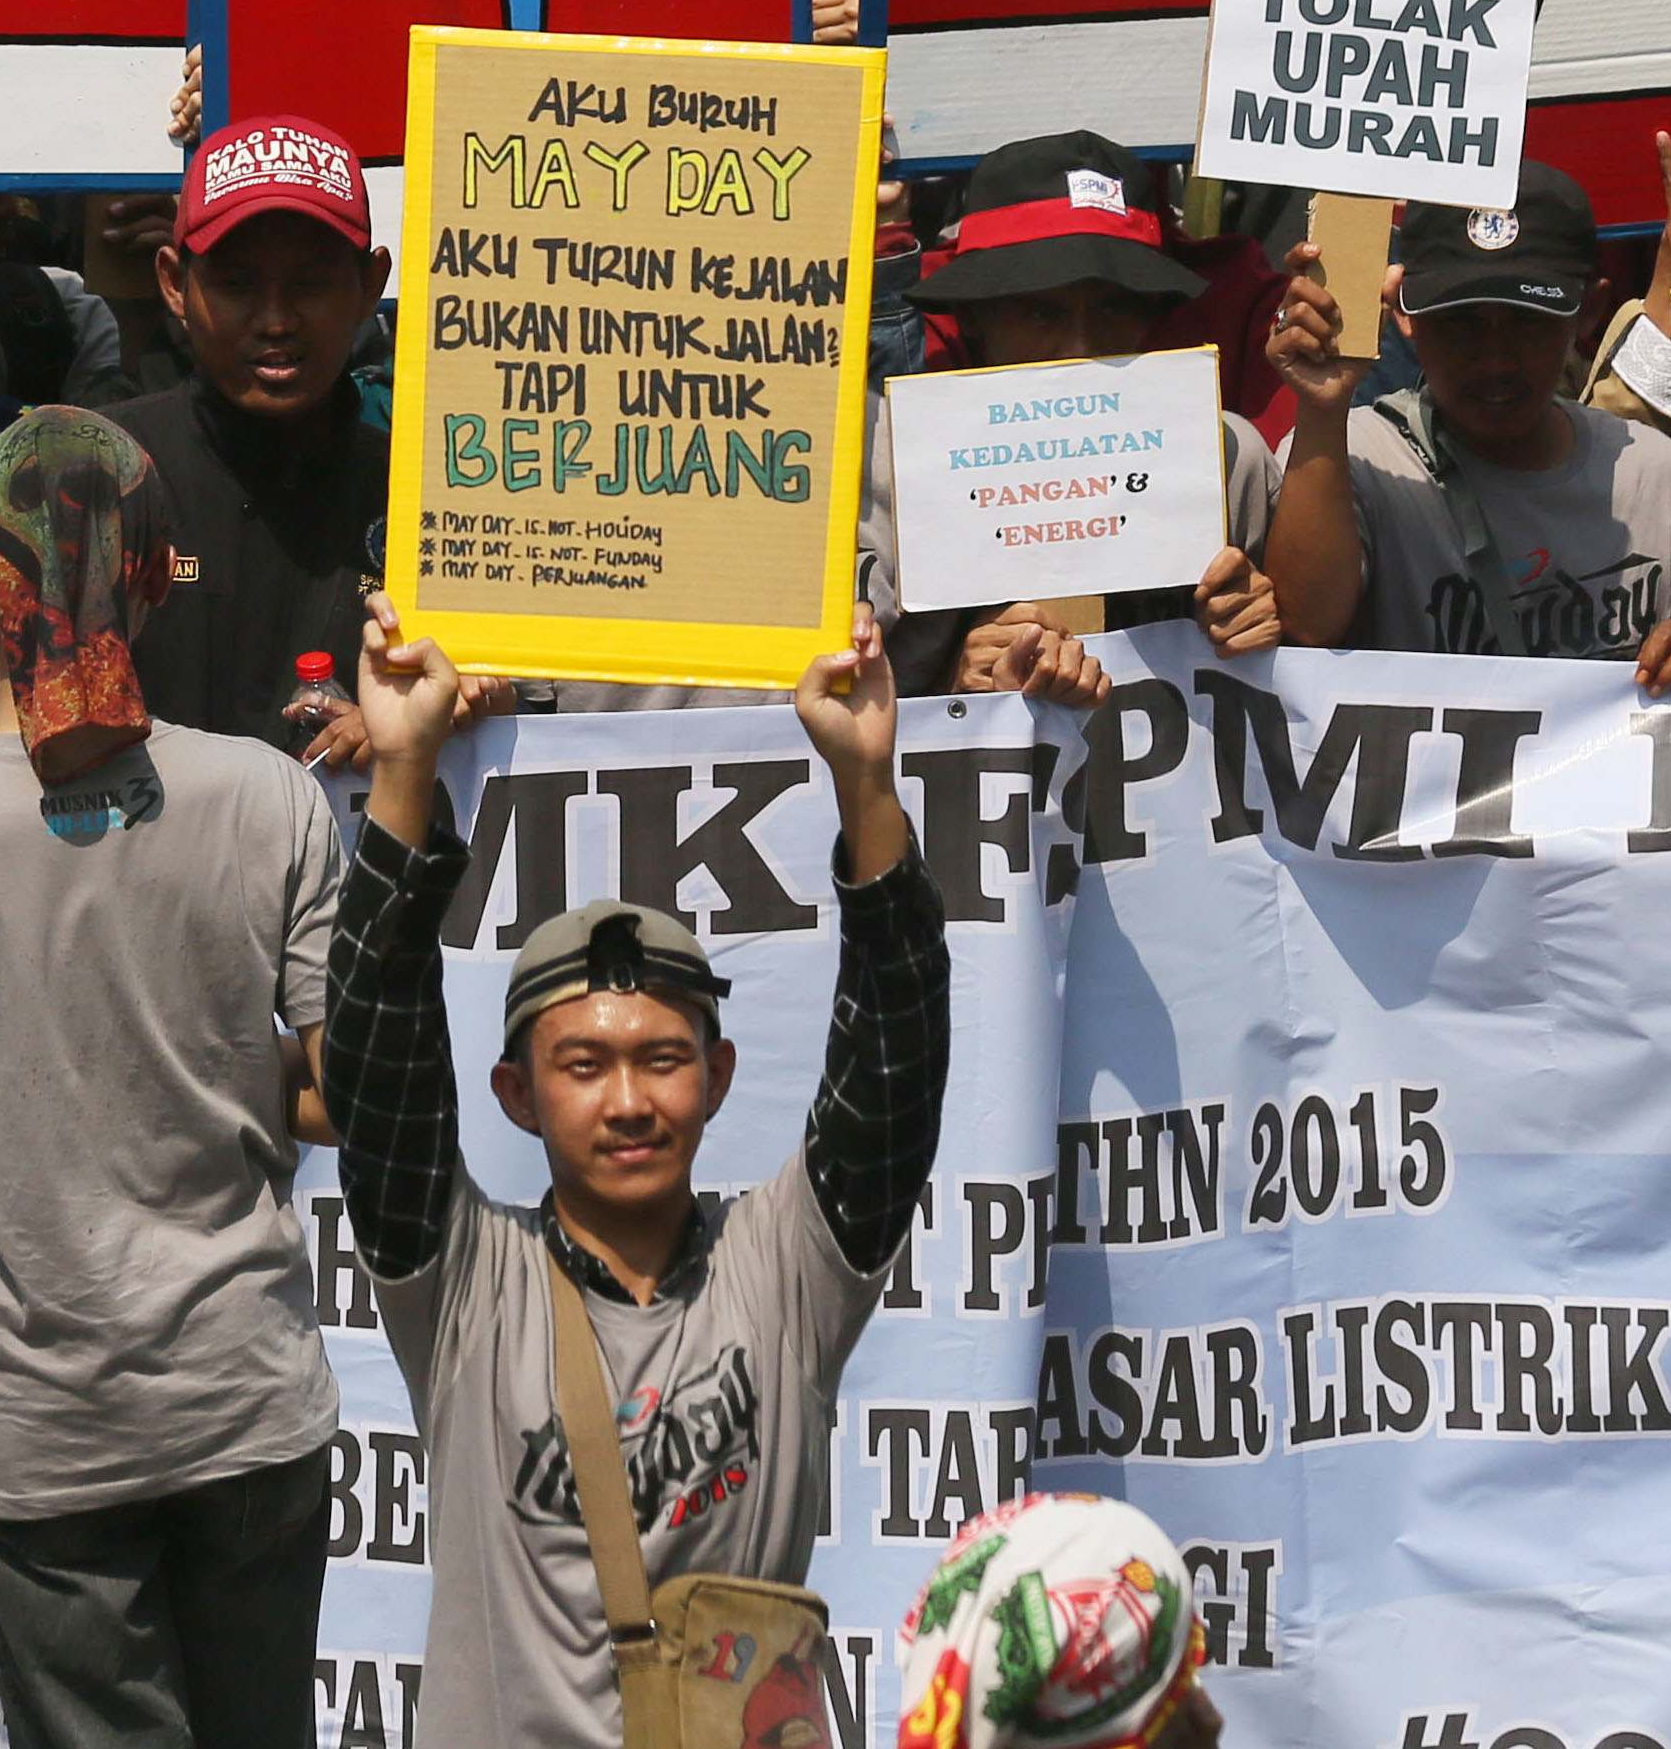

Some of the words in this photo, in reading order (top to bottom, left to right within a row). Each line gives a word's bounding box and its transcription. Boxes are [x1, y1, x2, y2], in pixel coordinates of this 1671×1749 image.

[1271, 29, 1471, 111] UPAH
[529, 77, 627, 125] AKU
[1229, 89, 1501, 170] MURAH
[205, 140, 351, 181] MAUNYA
[206, 131, 265, 164] KALO
[271, 126, 350, 161] TUHAN
[205, 164, 256, 191] KAMU
[260, 160, 315, 173] SAMA
[318, 168, 352, 189] AKU
[462, 131, 650, 213] MAY
[667, 145, 812, 221] DAY
[431, 228, 517, 280] AKU
[533, 237, 674, 291] TURUN
[434, 295, 568, 354] BUKAN
[579, 306, 707, 356] UNTUK
[494, 361, 585, 416] TAPI
[618, 369, 772, 420] UNTUK
[986, 391, 1122, 427] BANGUN
[444, 412, 812, 504] BERJUANG
[947, 428, 1166, 472] KEDAULATAN
[1055, 1102, 1227, 1247] THN
[1249, 1085, 1447, 1228] 2015
